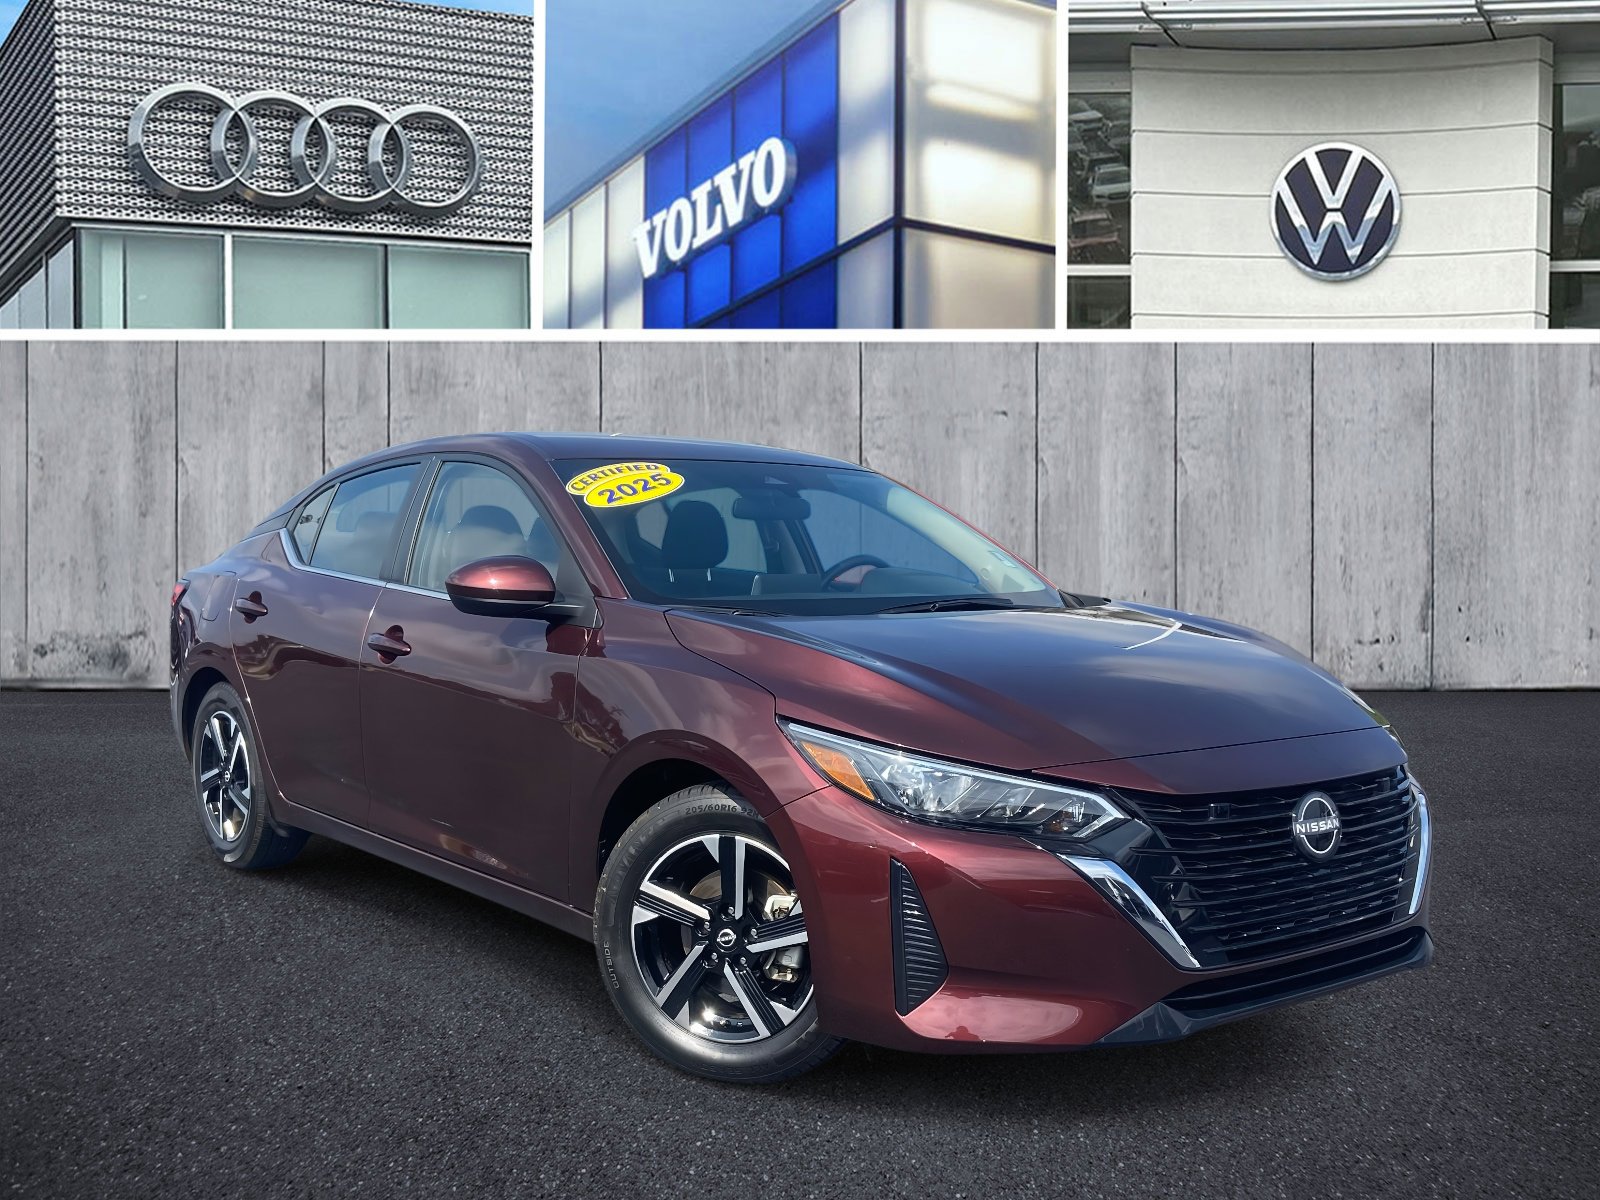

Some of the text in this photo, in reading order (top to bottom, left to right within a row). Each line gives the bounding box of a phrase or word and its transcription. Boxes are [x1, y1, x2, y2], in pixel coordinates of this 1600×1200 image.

[632, 136, 787, 279] VOLVO
[570, 463, 661, 492] CERTIFIED
[597, 472, 673, 505] 2025
[685, 803, 738, 816] 205/60R16
[1295, 817, 1340, 834] NISSAN
[603, 941, 620, 989] OUTSIDE
